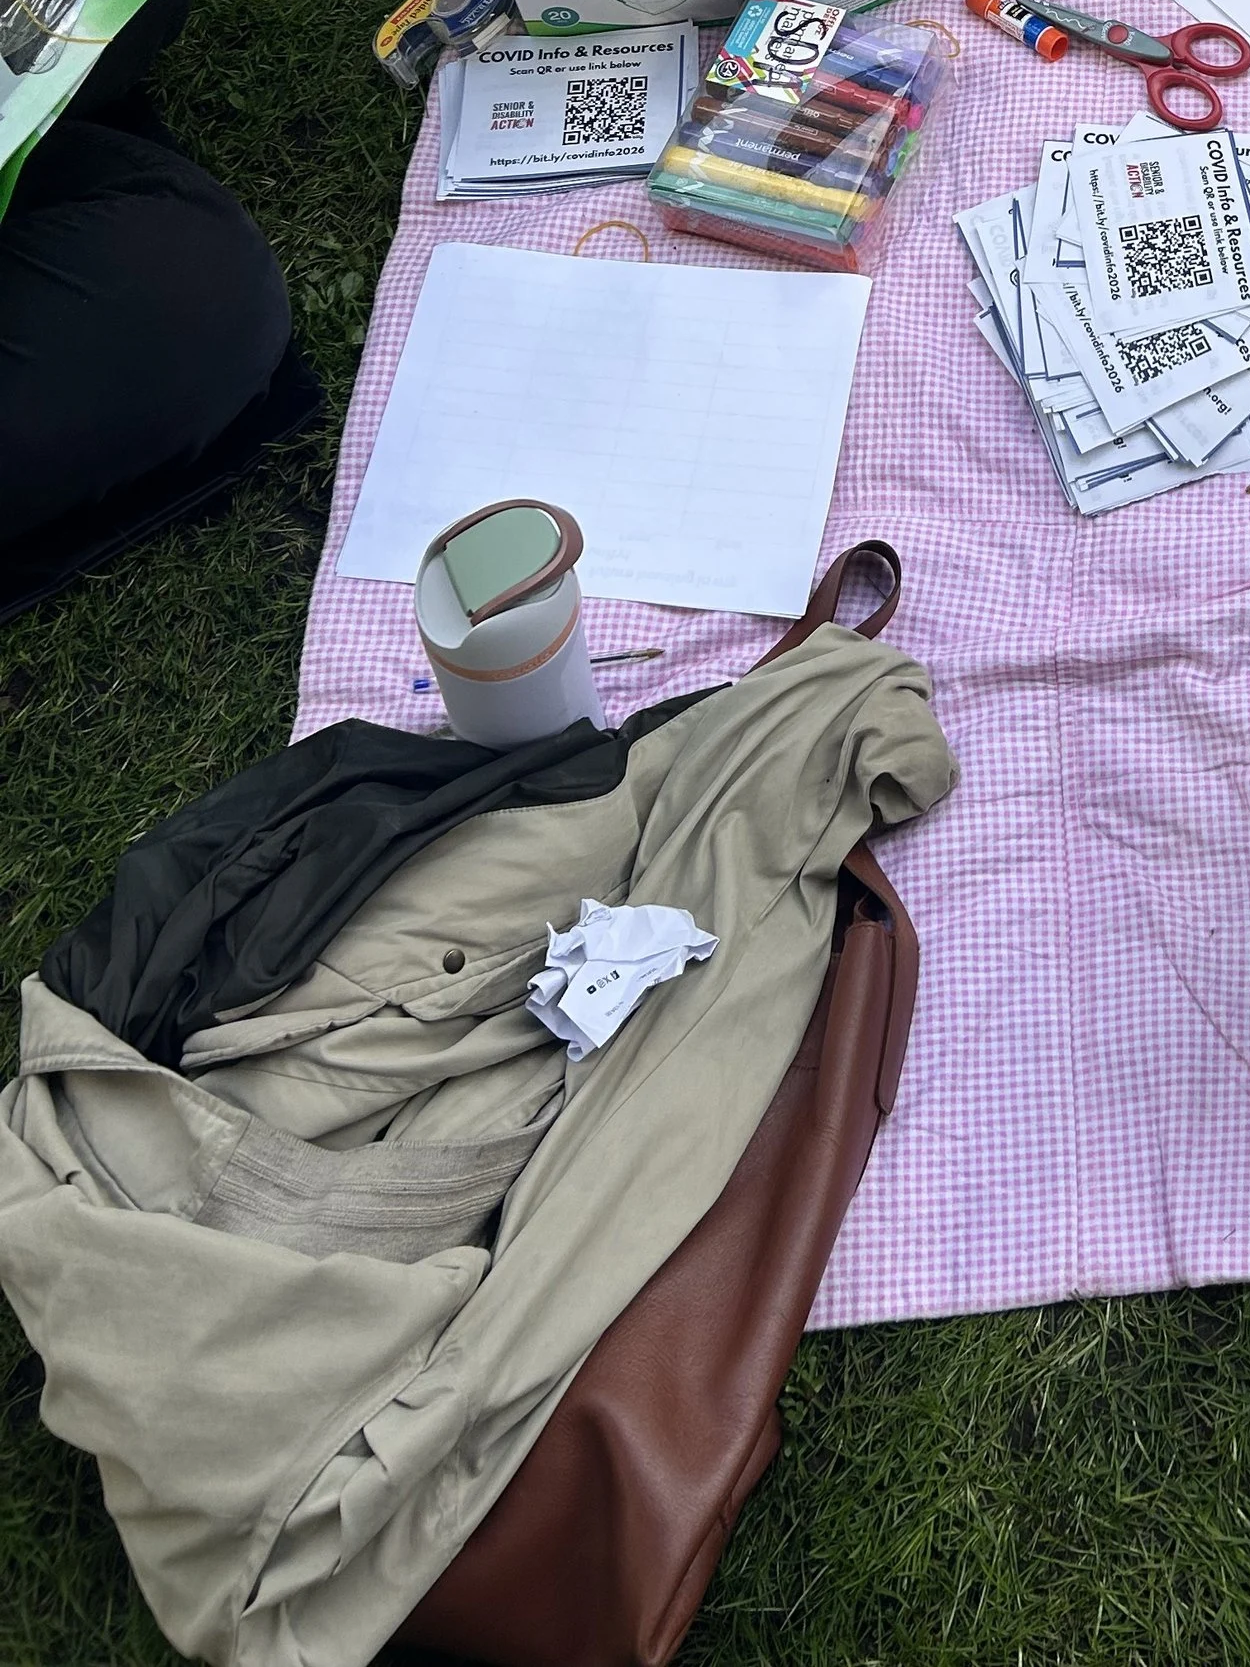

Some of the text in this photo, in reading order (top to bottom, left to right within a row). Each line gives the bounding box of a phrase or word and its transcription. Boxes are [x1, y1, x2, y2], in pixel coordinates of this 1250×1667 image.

[548, 9, 571, 21] 20
[478, 41, 674, 64] COVID Info & Resources
[509, 67, 534, 76] Scan
[536, 65, 553, 74] QR
[569, 63, 586, 71] use
[588, 61, 607, 70] link
[609, 59, 642, 69] below
[492, 101, 535, 112] SENIOR &
[492, 110, 534, 119] DISABILITY
[490, 118, 535, 131] ACTION
[1084, 133, 1121, 145] COV
[489, 146, 645, 167] https://bit.ly/covidinfo2026
[736, 138, 800, 162] permanent
[1140, 162, 1154, 195] DISABILITY
[1150, 161, 1165, 195] SENIOR &
[1206, 139, 1250, 301] COVID Info & Resources
[1090, 168, 1121, 301] https://bit.ly/covidinfo2026
